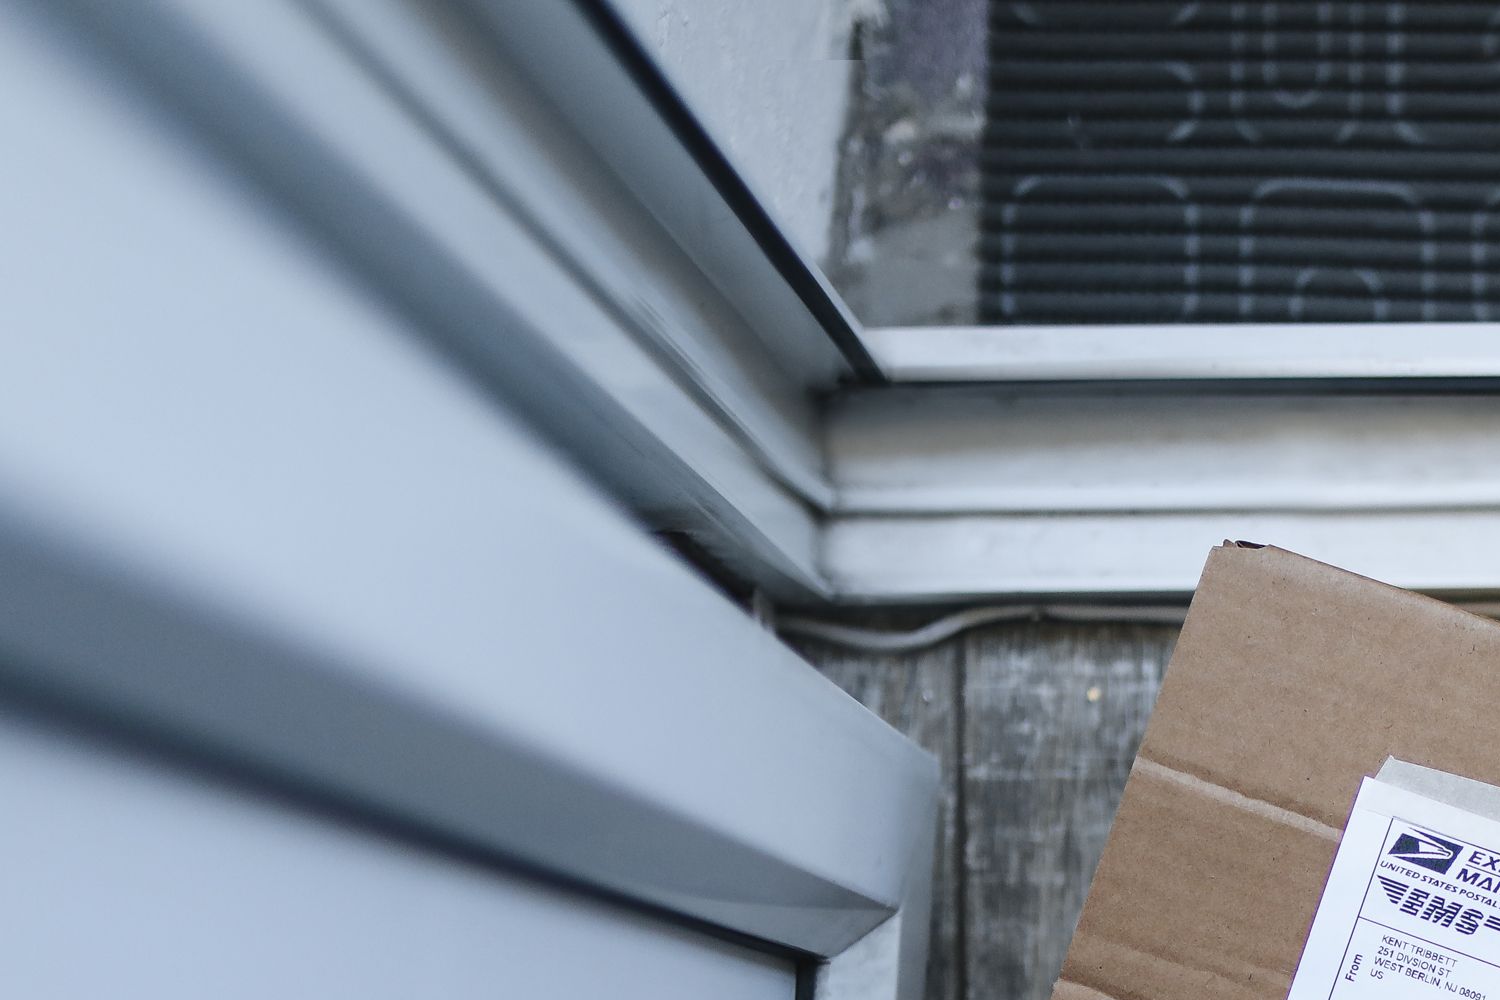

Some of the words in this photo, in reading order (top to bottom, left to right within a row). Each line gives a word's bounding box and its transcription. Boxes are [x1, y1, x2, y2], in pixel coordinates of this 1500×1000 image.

[1379, 859, 1420, 879] UNITED
[1420, 875, 1459, 893] STATES
[1458, 888, 1497, 908] POSTAL
[1398, 886, 1484, 935] EMS
[1376, 945, 1394, 958] 251
[1395, 951, 1437, 974] DIVSION
[1437, 966, 1452, 978] ST
[1381, 934, 1409, 950] KENT
[1410, 943, 1458, 967] TRIBBETT
[1344, 953, 1363, 982] From
[1369, 968, 1384, 980] US
[1373, 955, 1404, 973] WEST
[1404, 967, 1441, 989] BERLIN,
[1443, 981, 1458, 993] NJ
